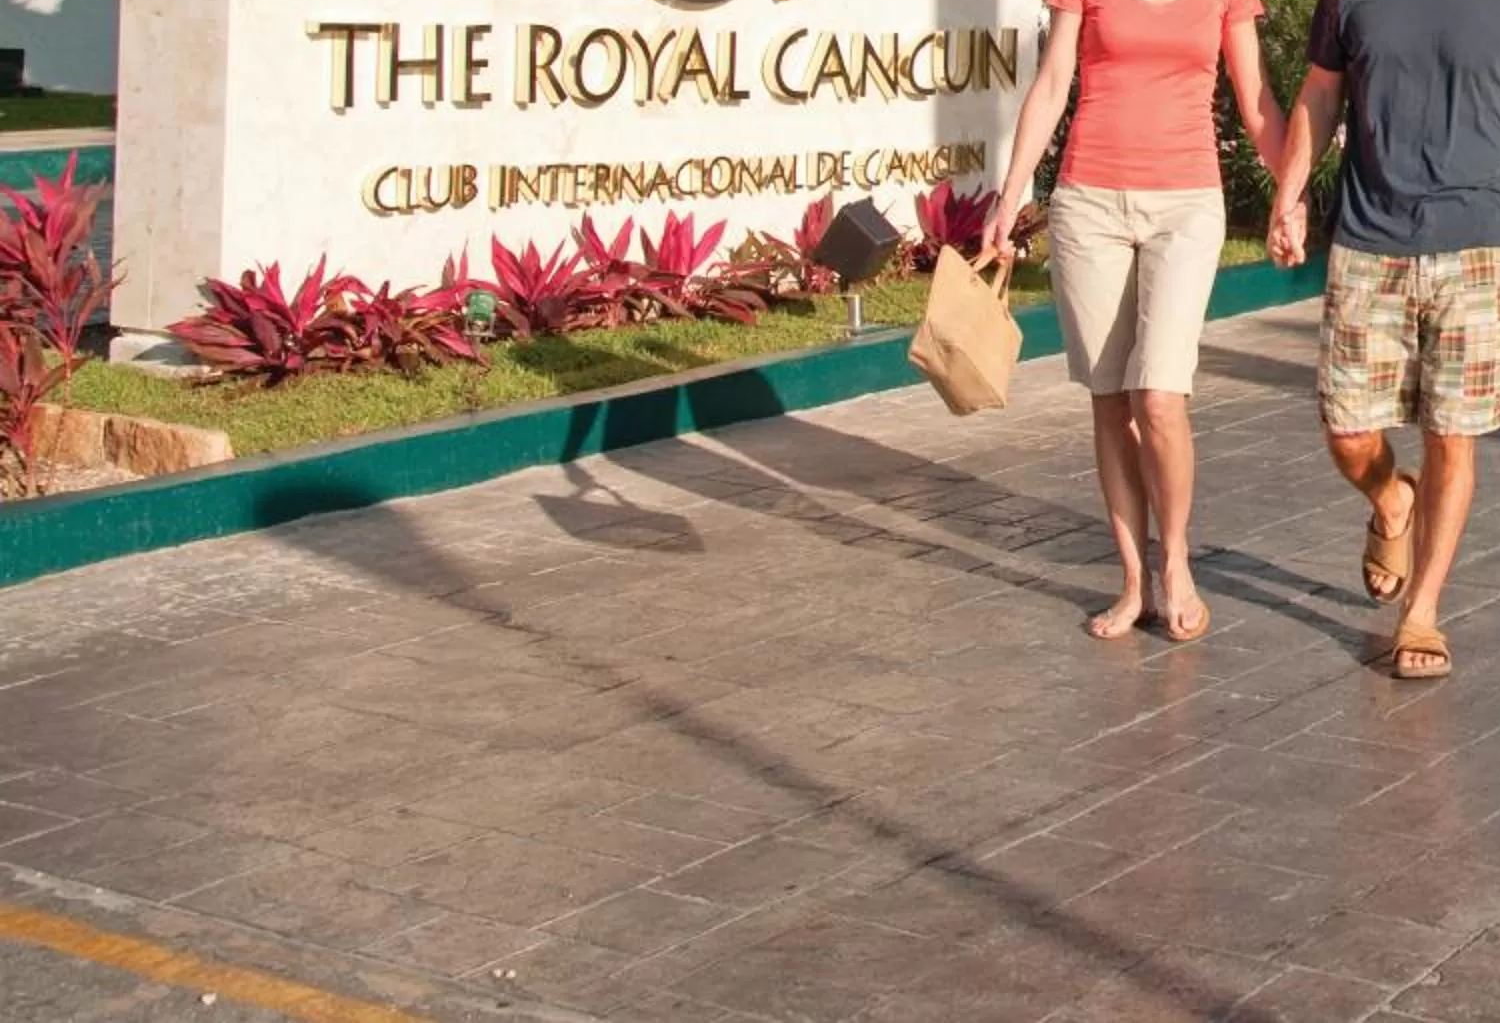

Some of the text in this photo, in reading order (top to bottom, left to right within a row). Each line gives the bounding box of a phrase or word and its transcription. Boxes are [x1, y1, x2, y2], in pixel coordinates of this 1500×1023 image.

[306, 22, 1019, 113] THE ROYAL CANCUN
[361, 162, 479, 216] CLUB
[488, 154, 803, 212] INTERNACIONAL
[806, 150, 852, 191] DE
